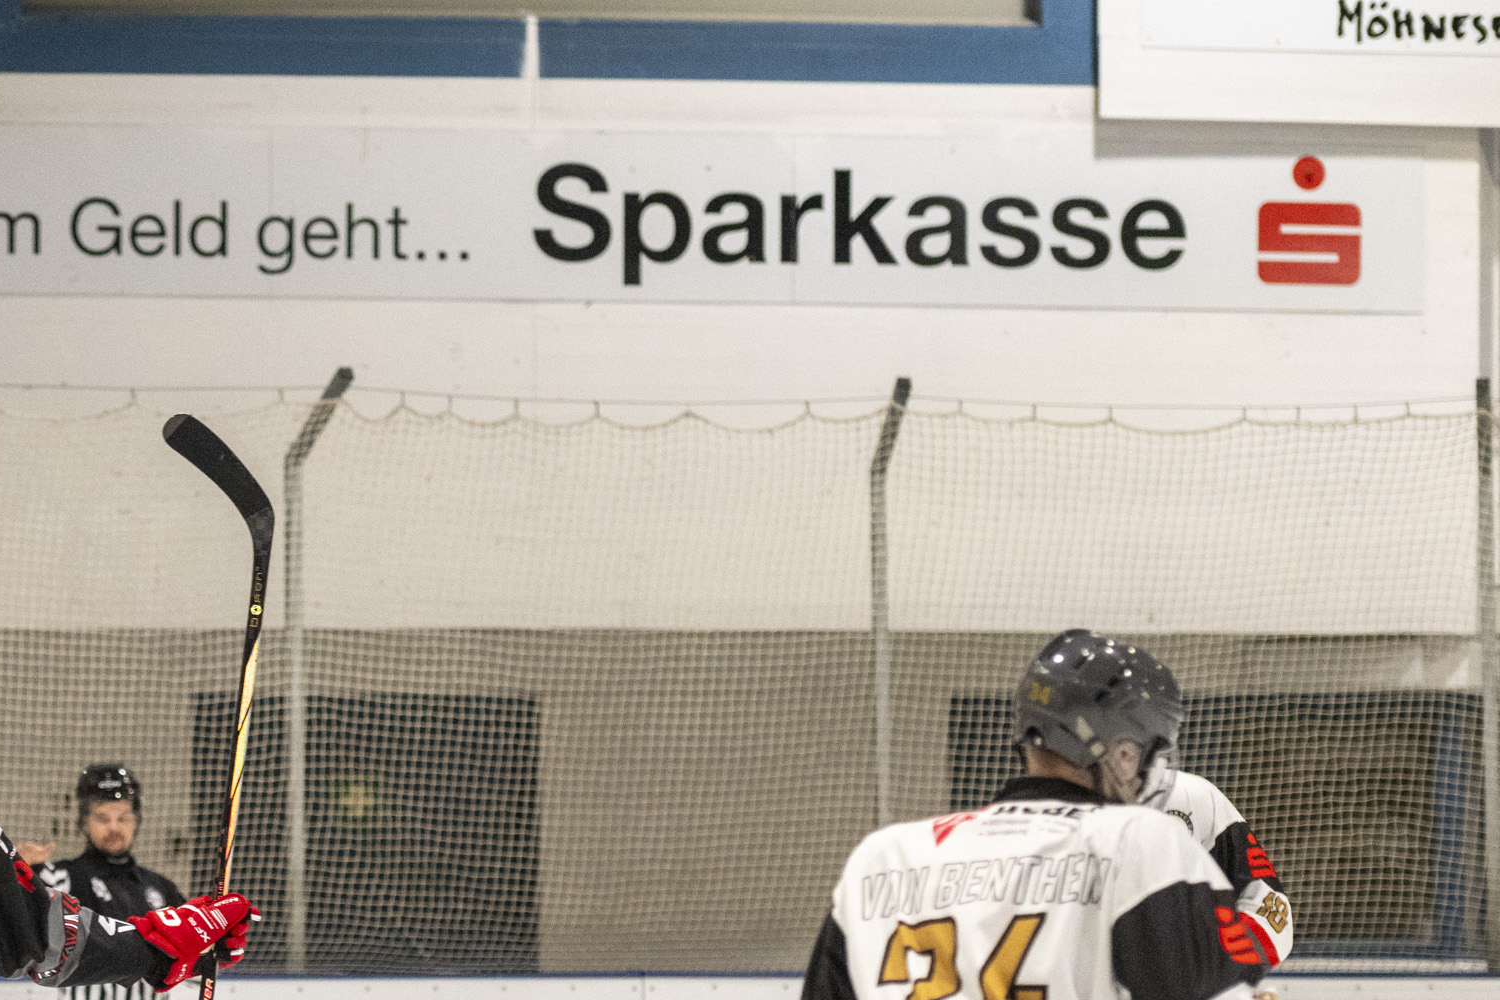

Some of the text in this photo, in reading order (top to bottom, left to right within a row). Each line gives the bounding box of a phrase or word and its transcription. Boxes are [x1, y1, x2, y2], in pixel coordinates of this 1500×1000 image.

[70, 196, 228, 257] Geld
[257, 202, 470, 274] geht...
[533, 162, 1187, 286] Sparkasse
